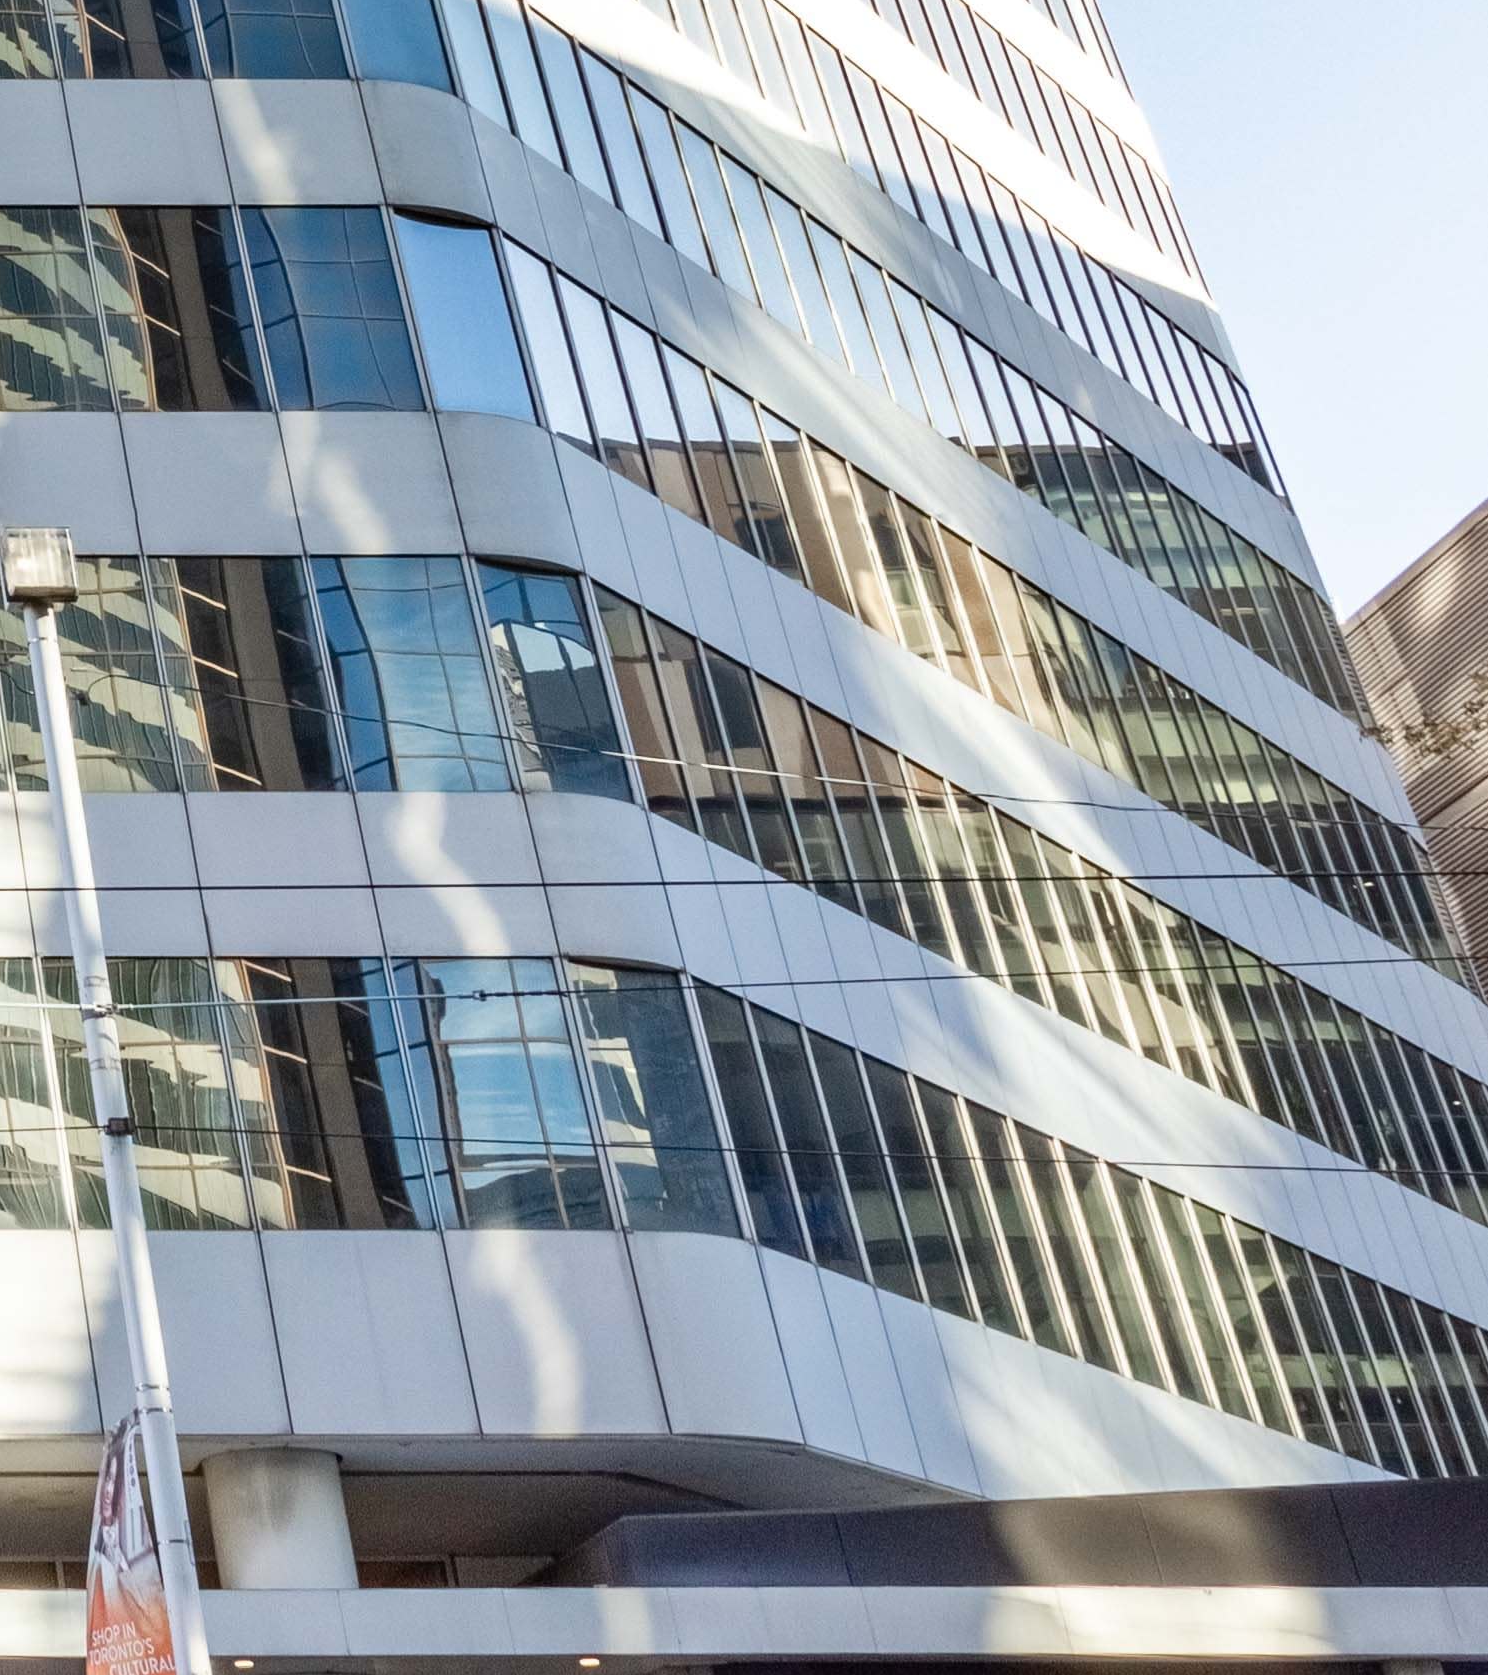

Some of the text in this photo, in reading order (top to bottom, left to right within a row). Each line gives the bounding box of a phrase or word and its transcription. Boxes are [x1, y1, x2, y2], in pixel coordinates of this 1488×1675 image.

[92, 1622, 136, 1647] SHOP IN
[89, 1637, 154, 1666] TORONTO'S
